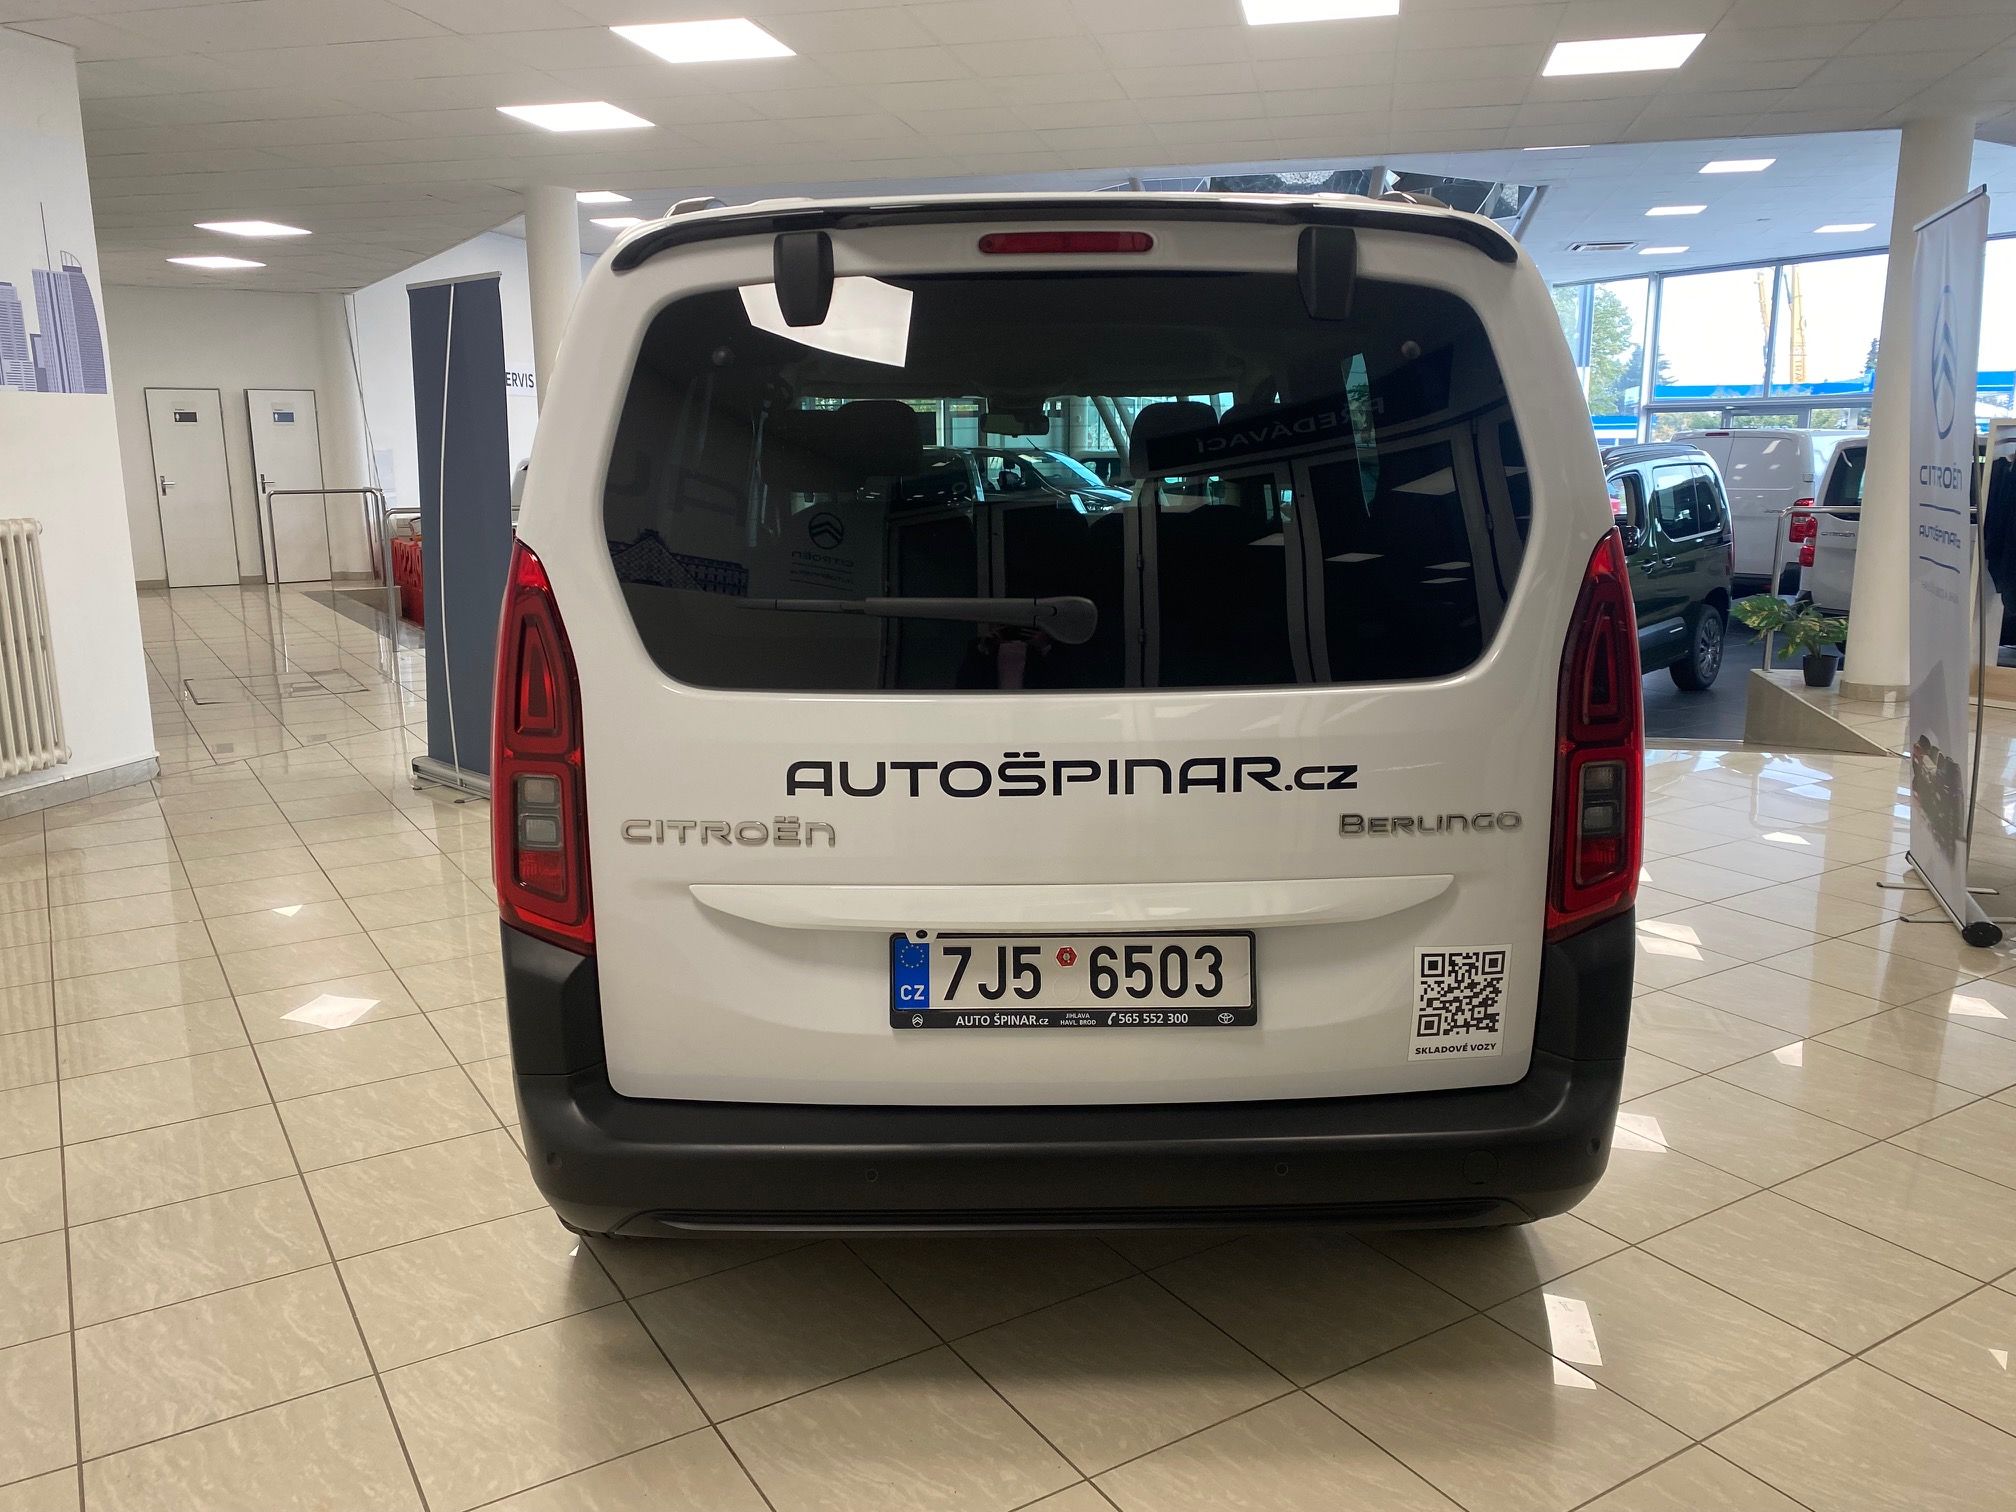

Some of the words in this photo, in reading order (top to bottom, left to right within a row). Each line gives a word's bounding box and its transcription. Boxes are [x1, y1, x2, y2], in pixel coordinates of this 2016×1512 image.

[505, 372, 535, 388] ERVIS
[785, 751, 1358, 798] AUTOŠPINAR.cz
[619, 814, 837, 848] CITROËN
[942, 945, 1042, 1002] 7J5
[1089, 944, 1224, 1000] 6503
[900, 984, 925, 1001] CZ
[955, 1014, 990, 1027] AUTO
[993, 1012, 1049, 1027] ŠPINAR.cz
[1118, 1013, 1140, 1025] 565
[1143, 1012, 1165, 1025] 552
[1168, 1012, 1189, 1025] 300
[1415, 1043, 1468, 1055] SKLADOVÉ
[1470, 1042, 1497, 1052] VOZY
